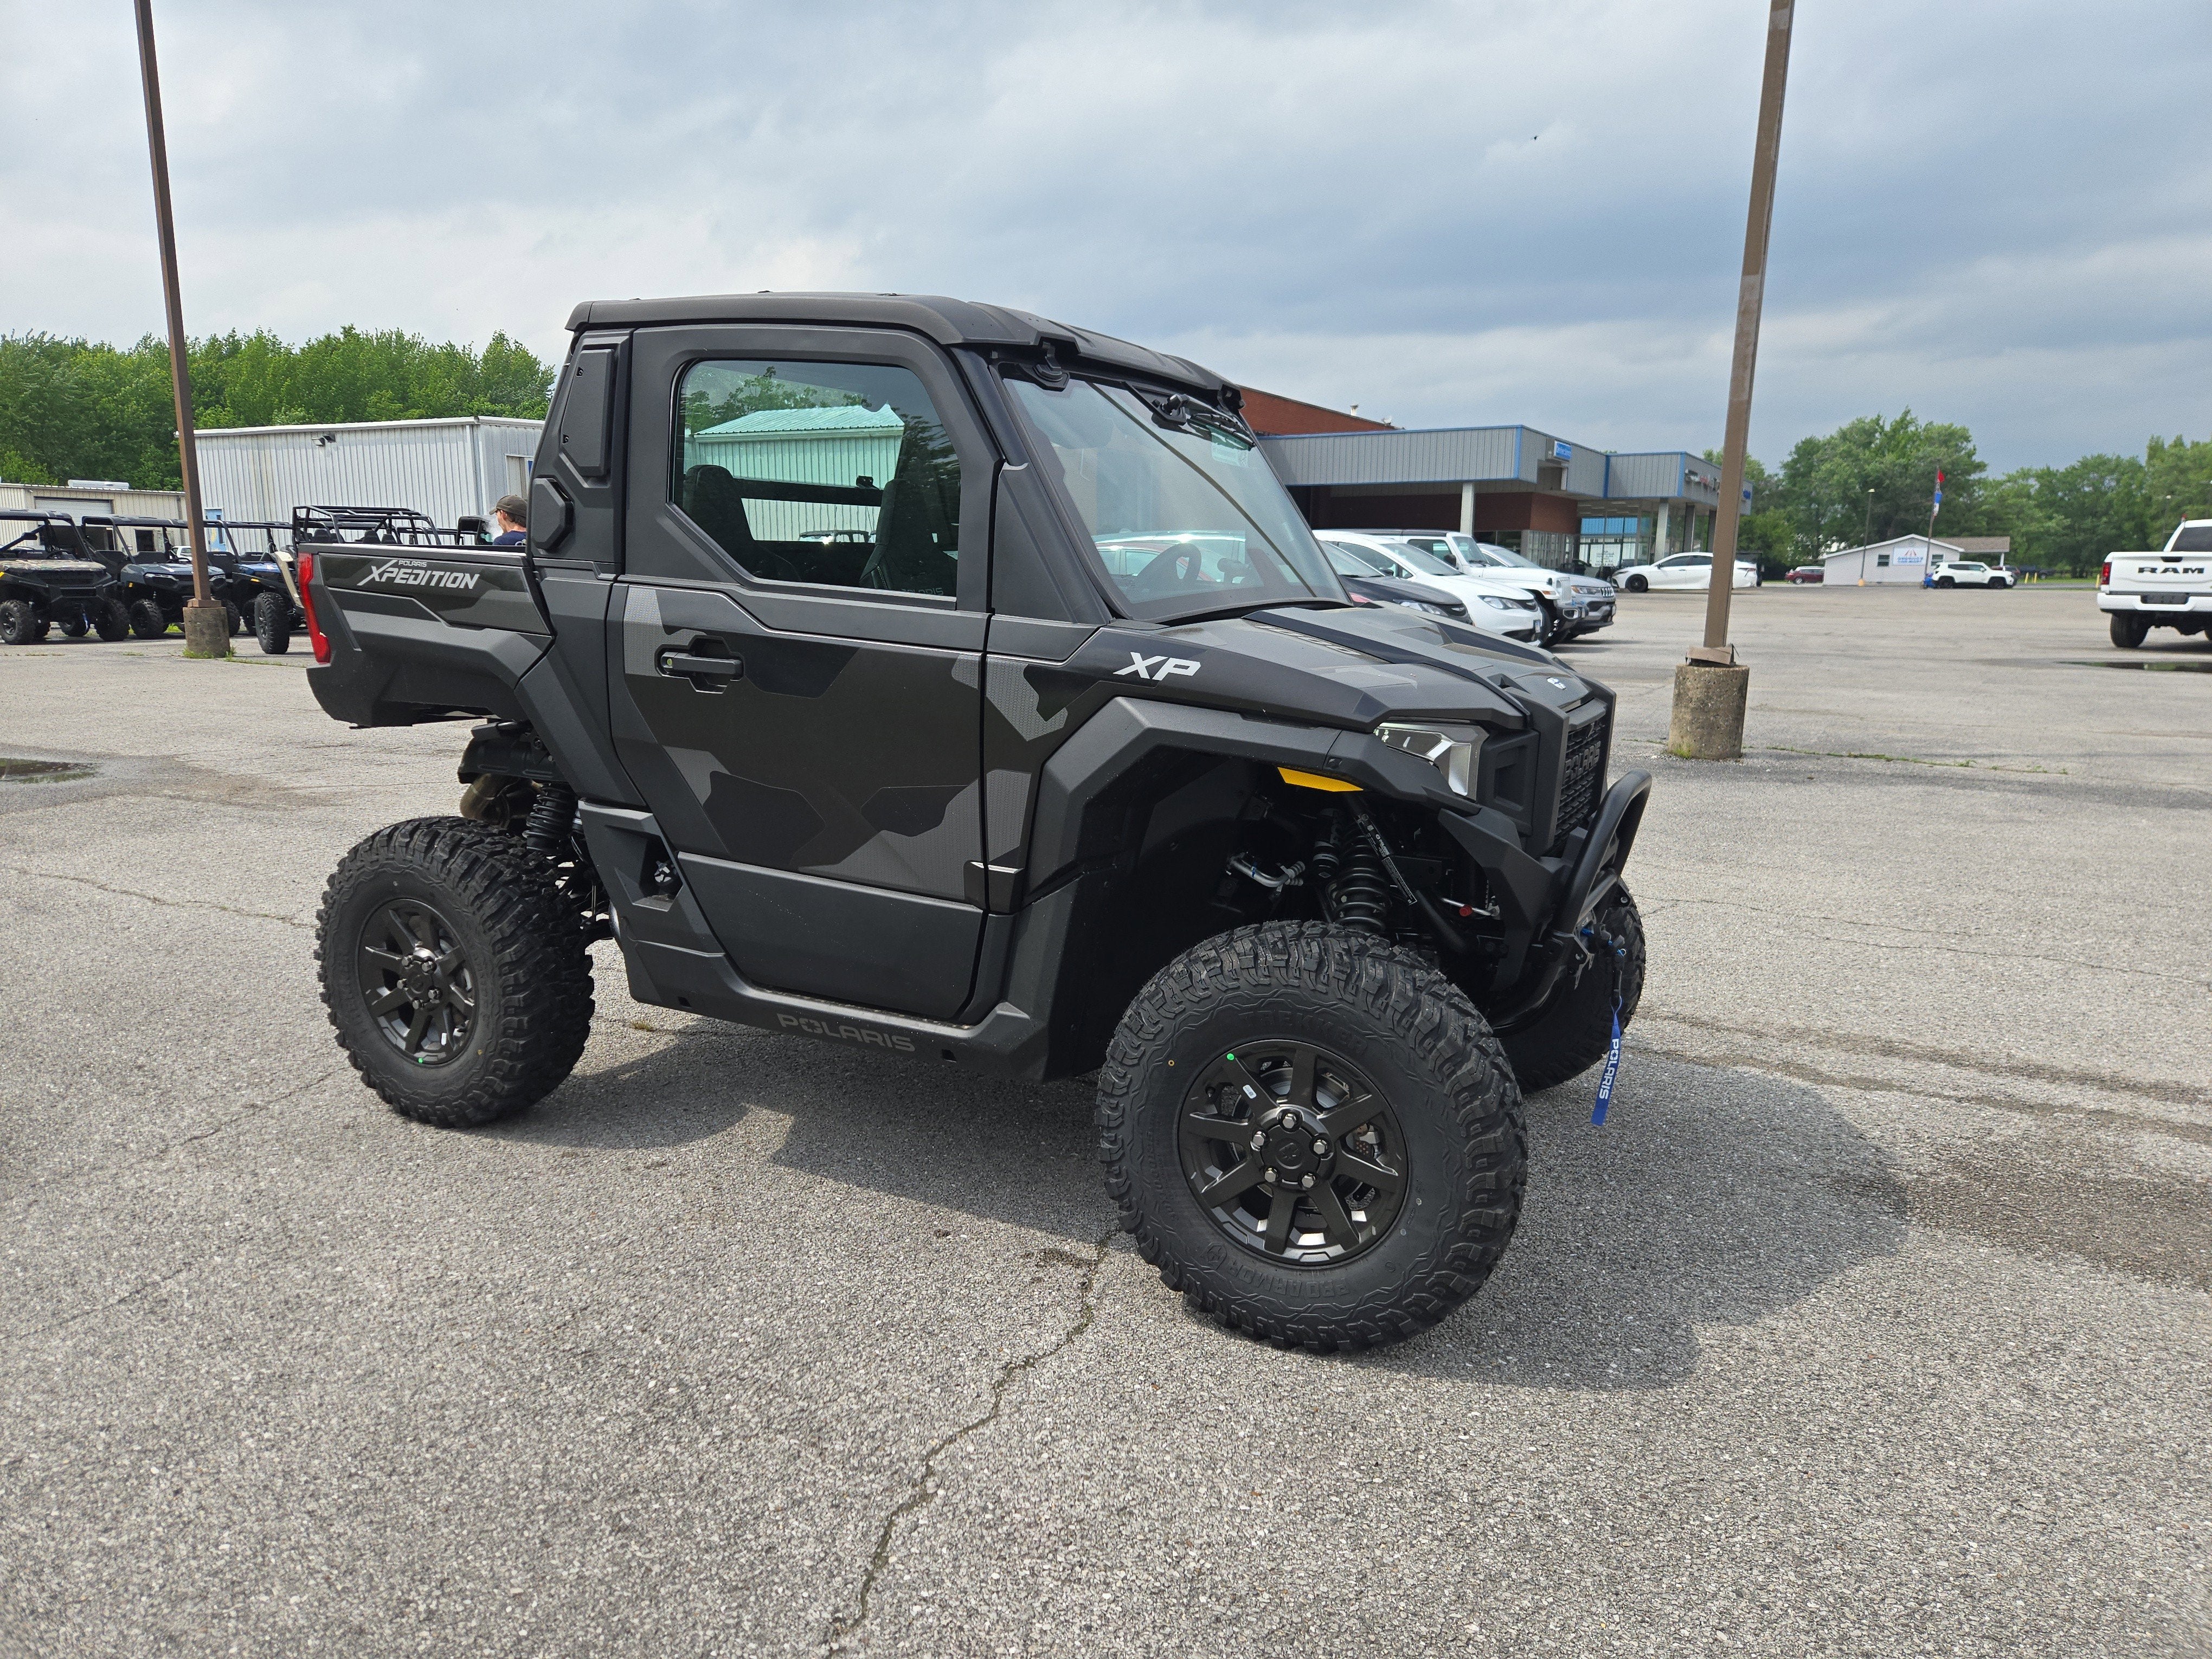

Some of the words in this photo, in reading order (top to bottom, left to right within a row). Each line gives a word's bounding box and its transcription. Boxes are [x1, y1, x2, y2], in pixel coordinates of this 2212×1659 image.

[356, 560, 480, 589] XPEDITION
[1113, 652, 1201, 681] XP
[1565, 741, 1602, 780] POLARIS
[776, 1013, 915, 1052] POLARIS
[1599, 1038, 1619, 1100] POLARIS
